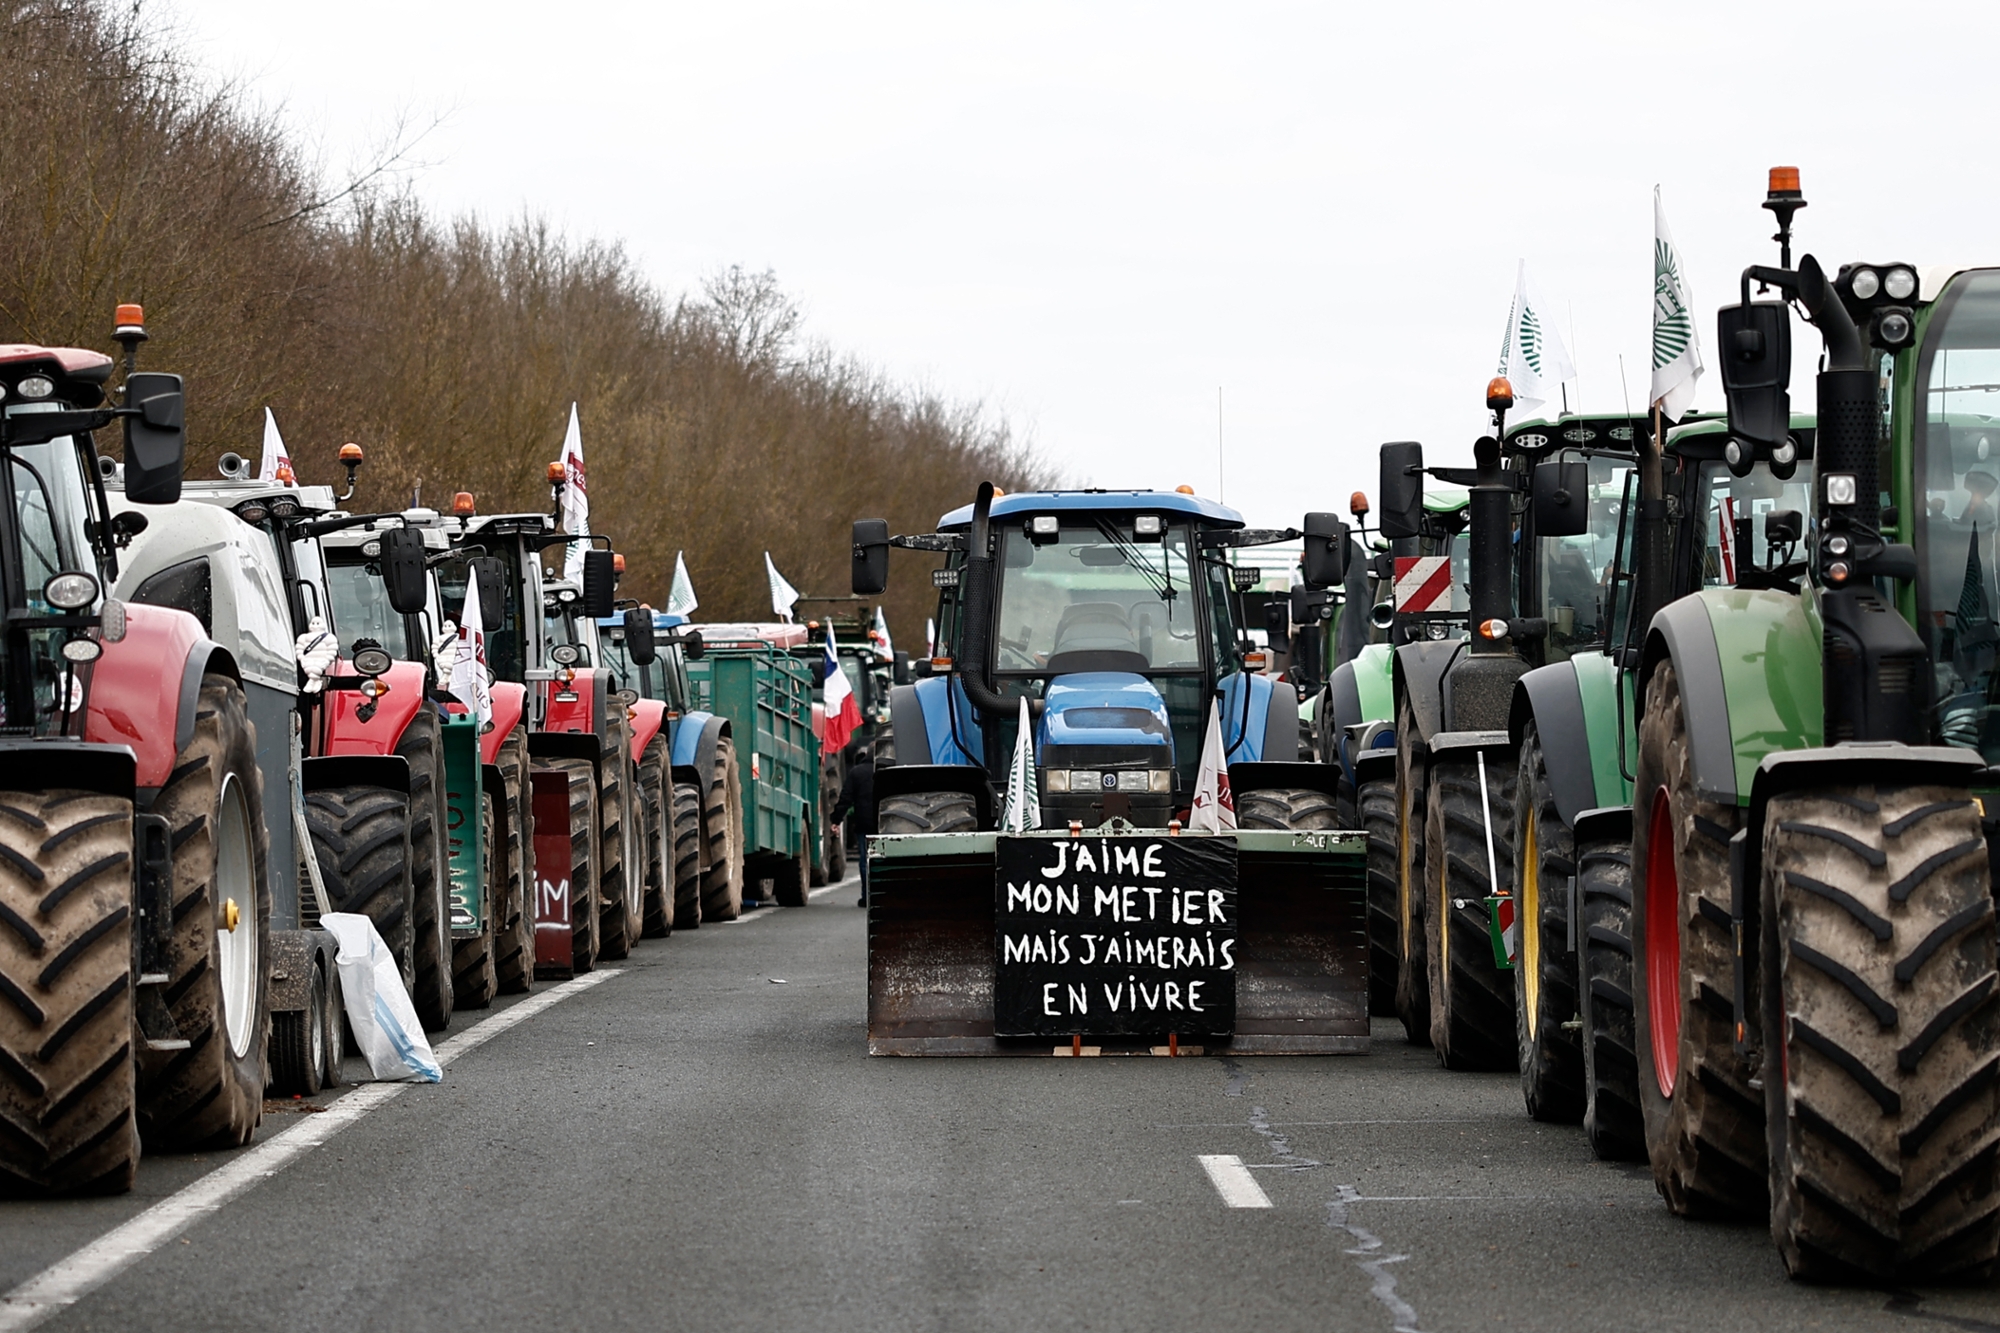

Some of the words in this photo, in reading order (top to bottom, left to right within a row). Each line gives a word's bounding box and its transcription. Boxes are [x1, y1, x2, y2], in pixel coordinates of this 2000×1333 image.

[1007, 880, 1080, 915] MON
[1004, 928, 1071, 965] MAIS
[1043, 982, 1088, 1016] EN
[1103, 974, 1206, 1012] VIVRE
